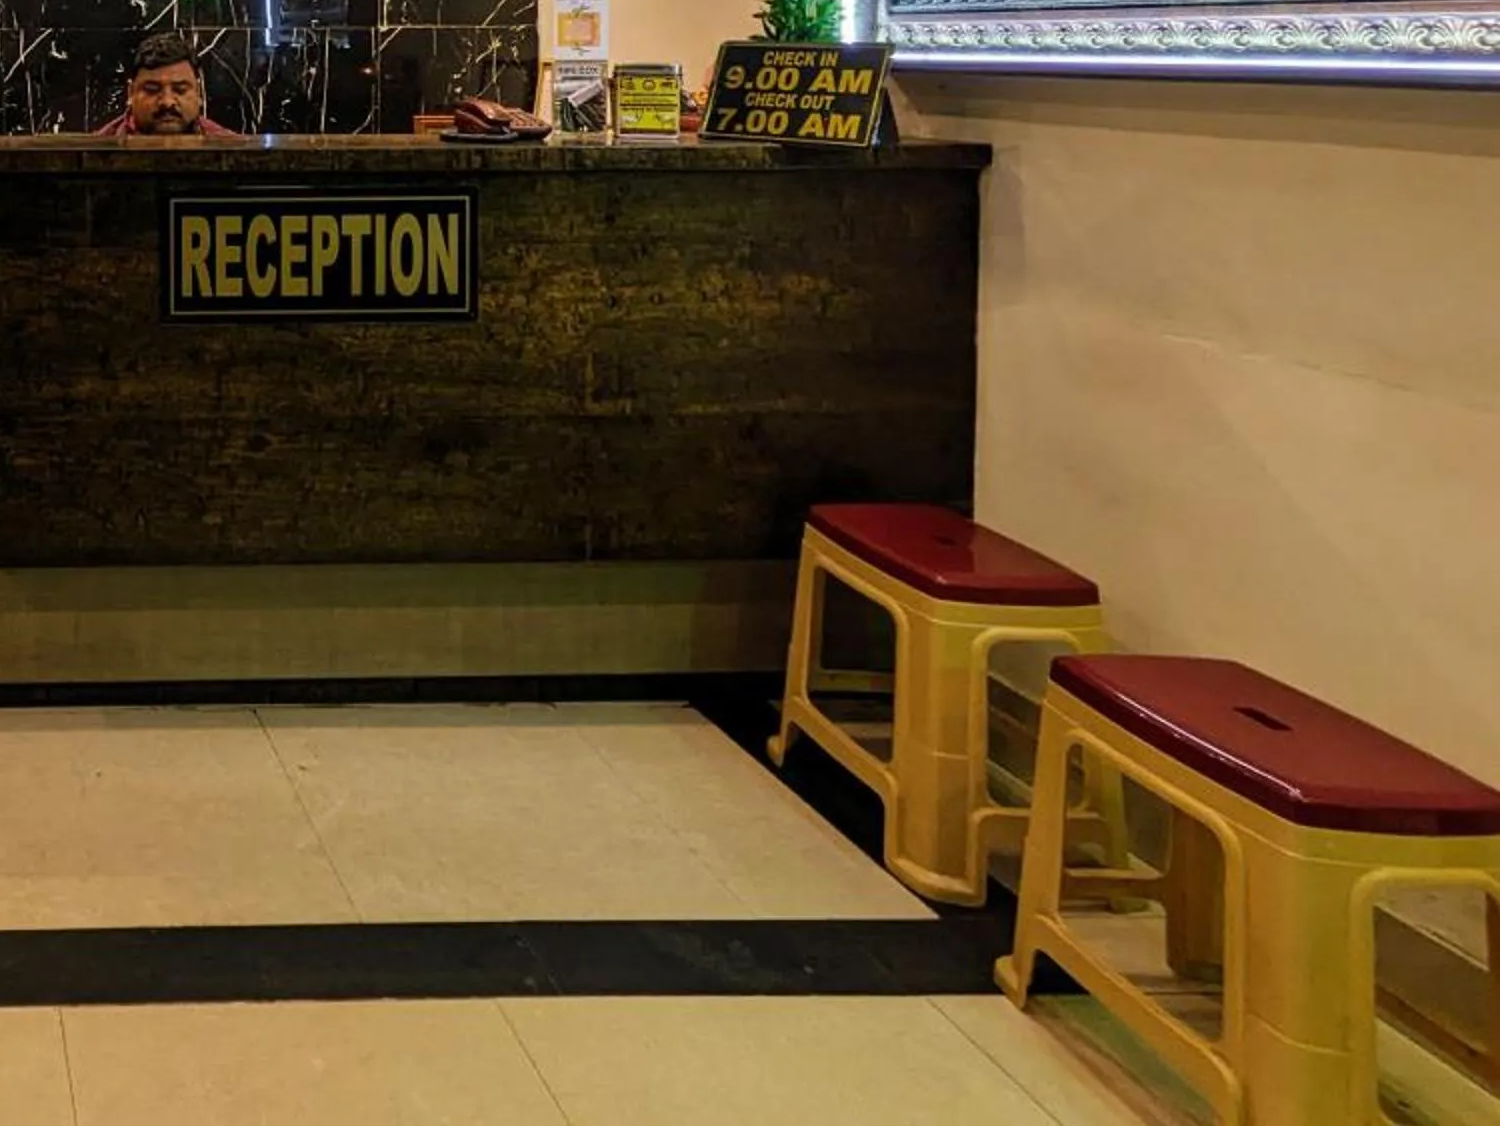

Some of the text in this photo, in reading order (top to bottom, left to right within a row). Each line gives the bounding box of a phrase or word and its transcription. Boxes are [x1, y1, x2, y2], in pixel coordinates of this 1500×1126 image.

[763, 51, 839, 67] CHECK IN
[724, 65, 873, 94] 9.00 AM
[745, 92, 836, 110] CHECK OUT
[716, 107, 862, 139] 7.00 AM
[181, 213, 459, 298] RECEPTION
